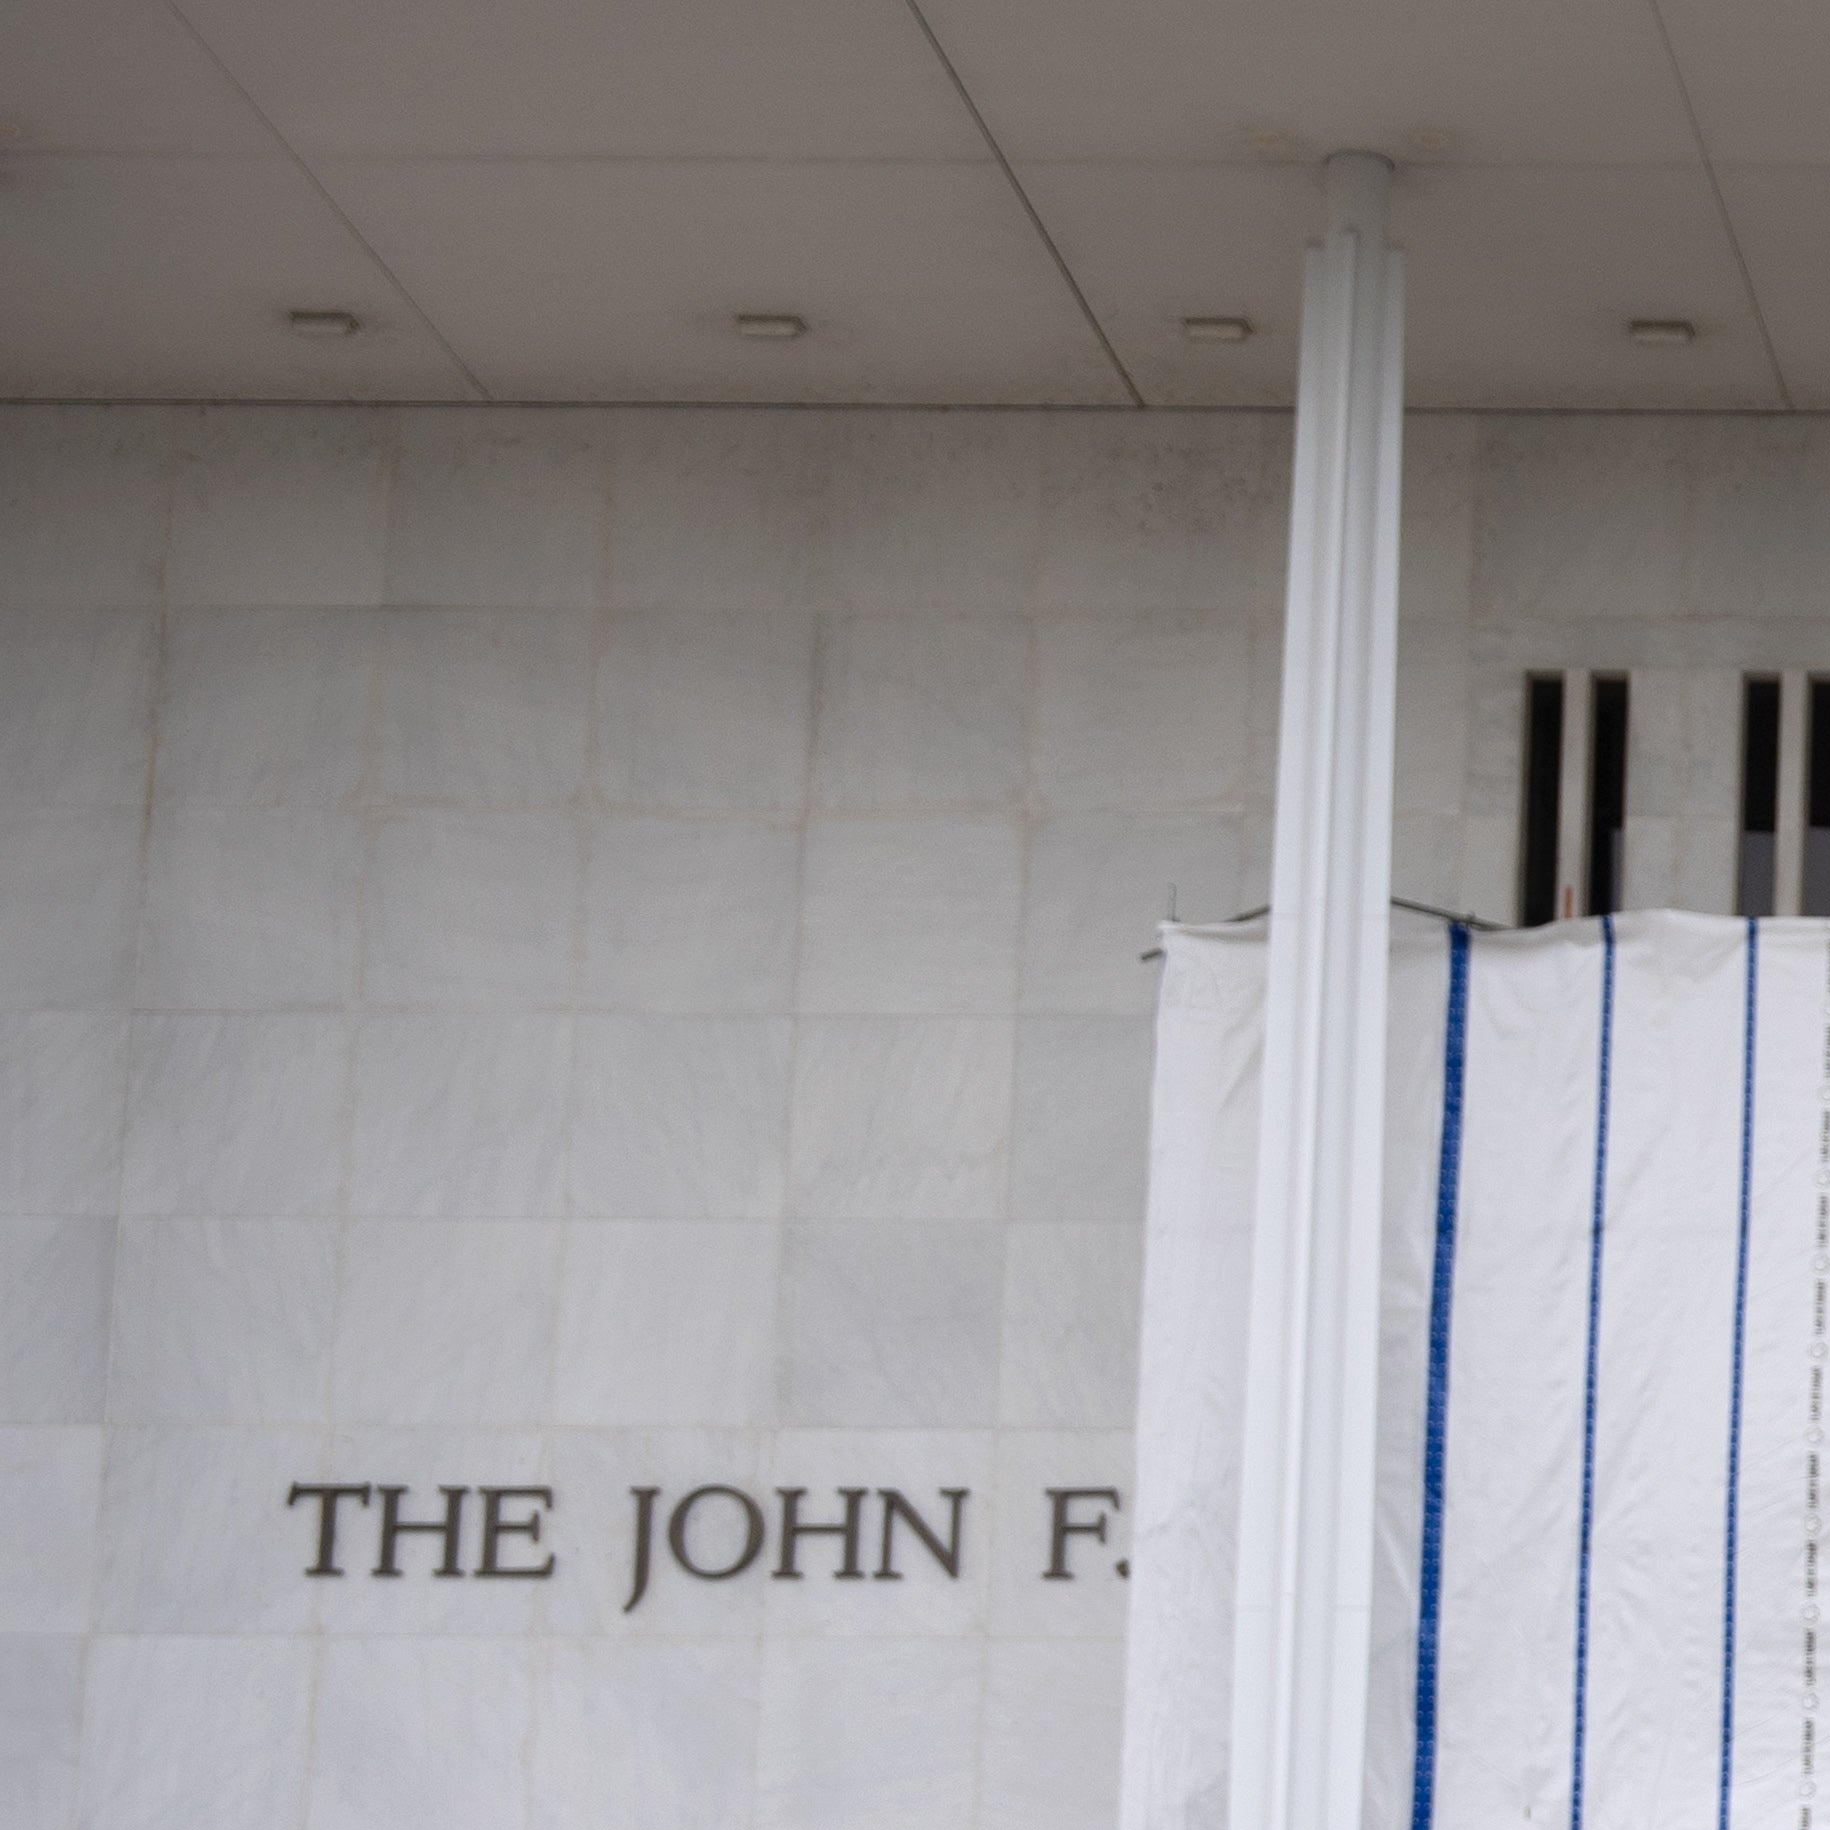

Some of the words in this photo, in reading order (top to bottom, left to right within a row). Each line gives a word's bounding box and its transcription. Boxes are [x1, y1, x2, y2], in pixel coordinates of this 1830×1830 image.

[286, 1482, 557, 1580] THE
[623, 1485, 970, 1613] JOHN
[1043, 1487, 1131, 1580] F.
